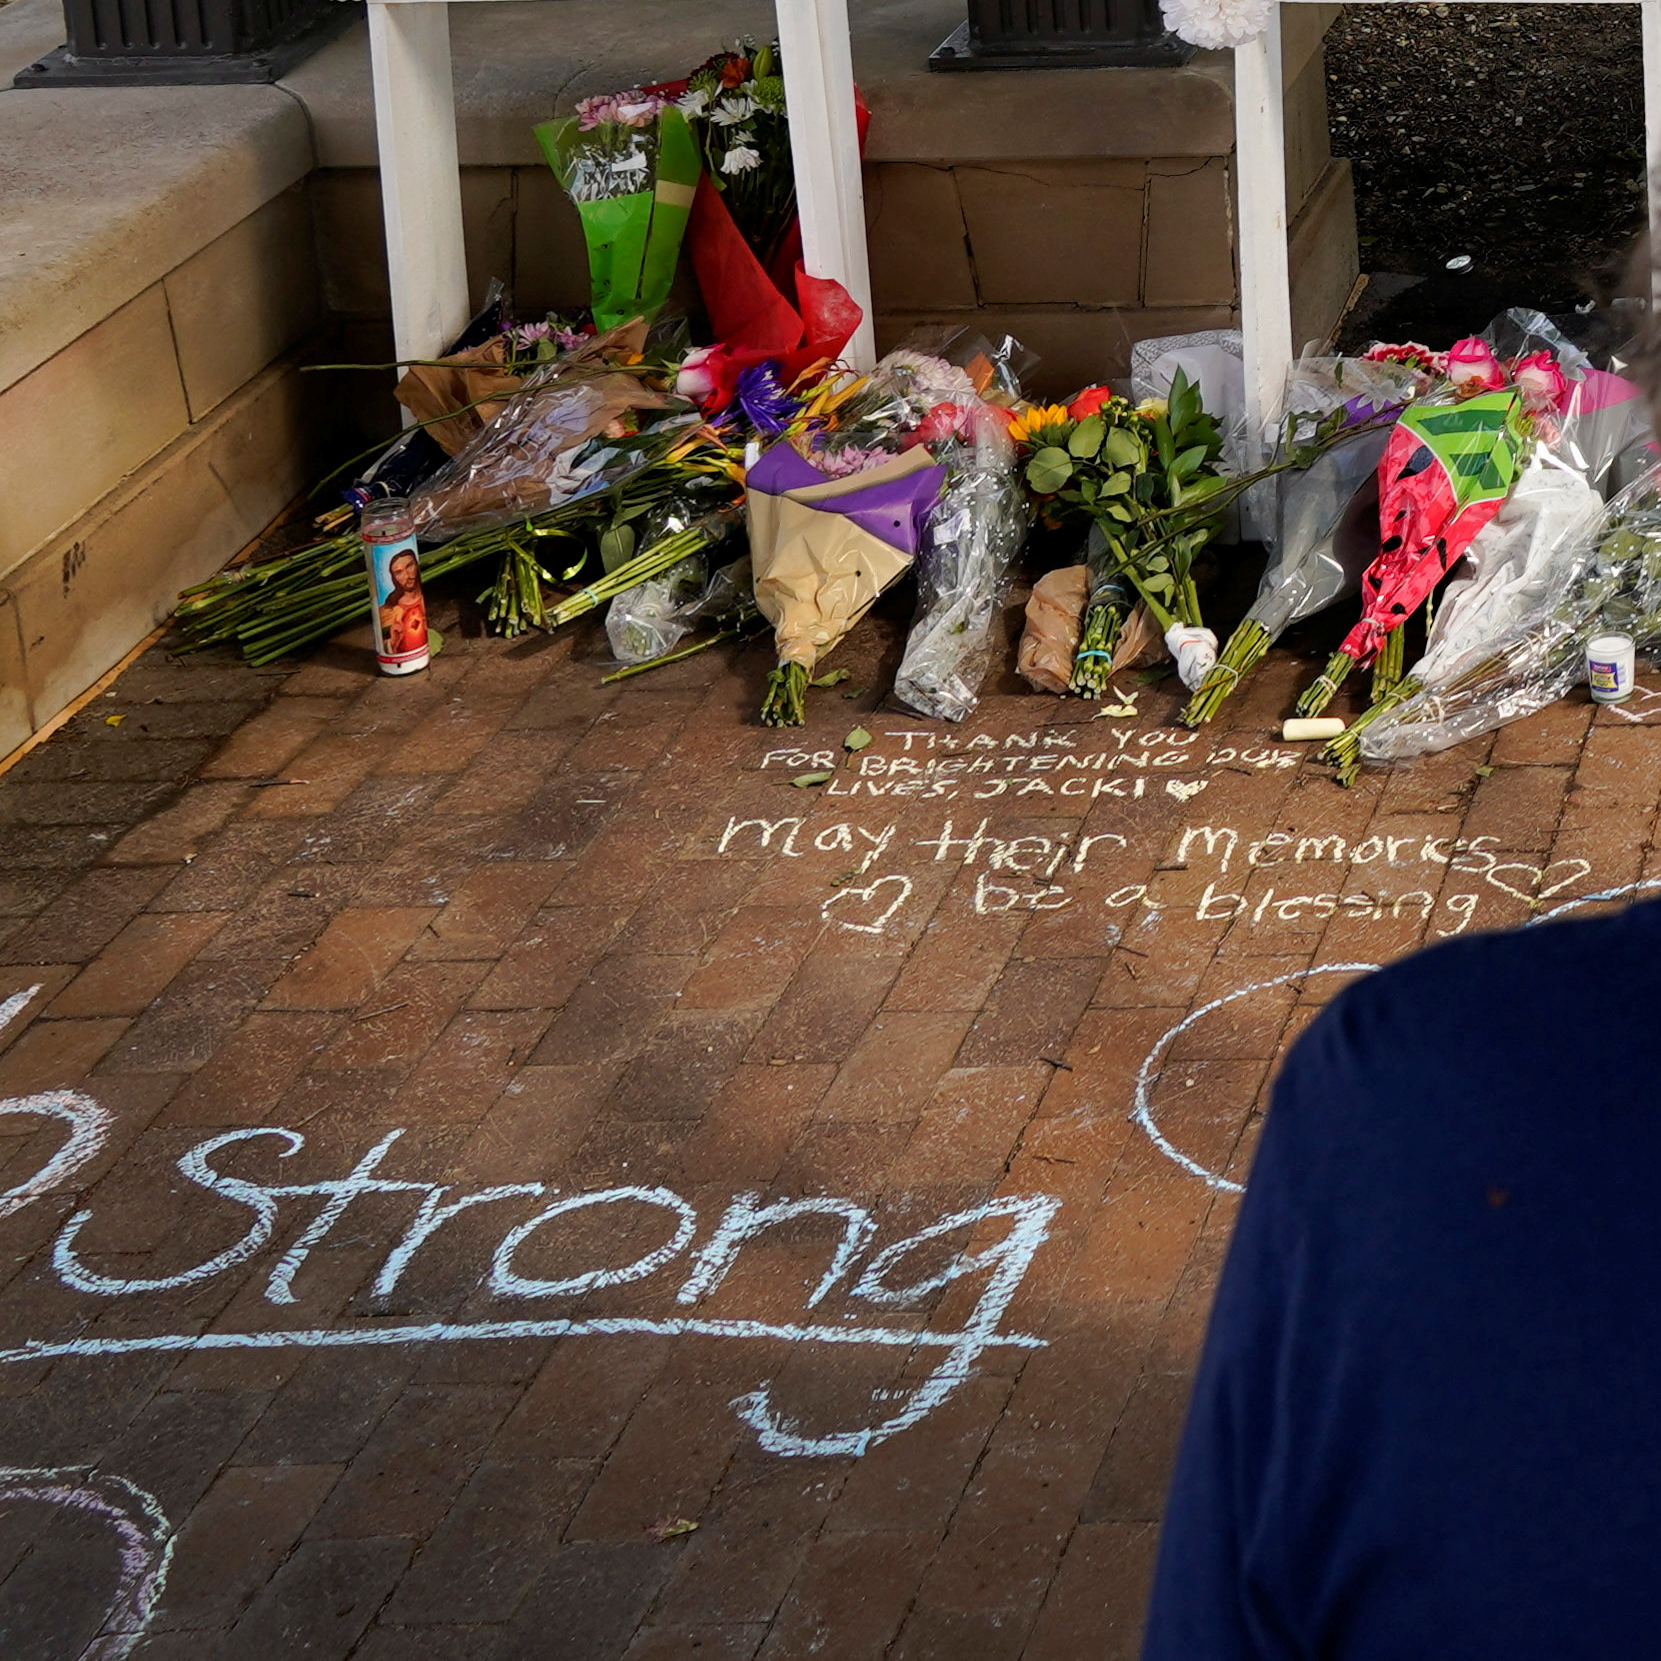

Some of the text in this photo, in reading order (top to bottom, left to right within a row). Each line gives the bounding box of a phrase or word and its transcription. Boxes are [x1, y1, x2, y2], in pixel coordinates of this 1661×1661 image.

[884, 727, 1201, 751] THANK YOU
[759, 749, 835, 770] FOR
[858, 751, 1188, 776] BRIGHTENING
[972, 776, 1145, 800] JACKI
[910, 817, 1127, 878] their
[975, 870, 1480, 938] be a blessing
[54, 1127, 1063, 1459] Strong
